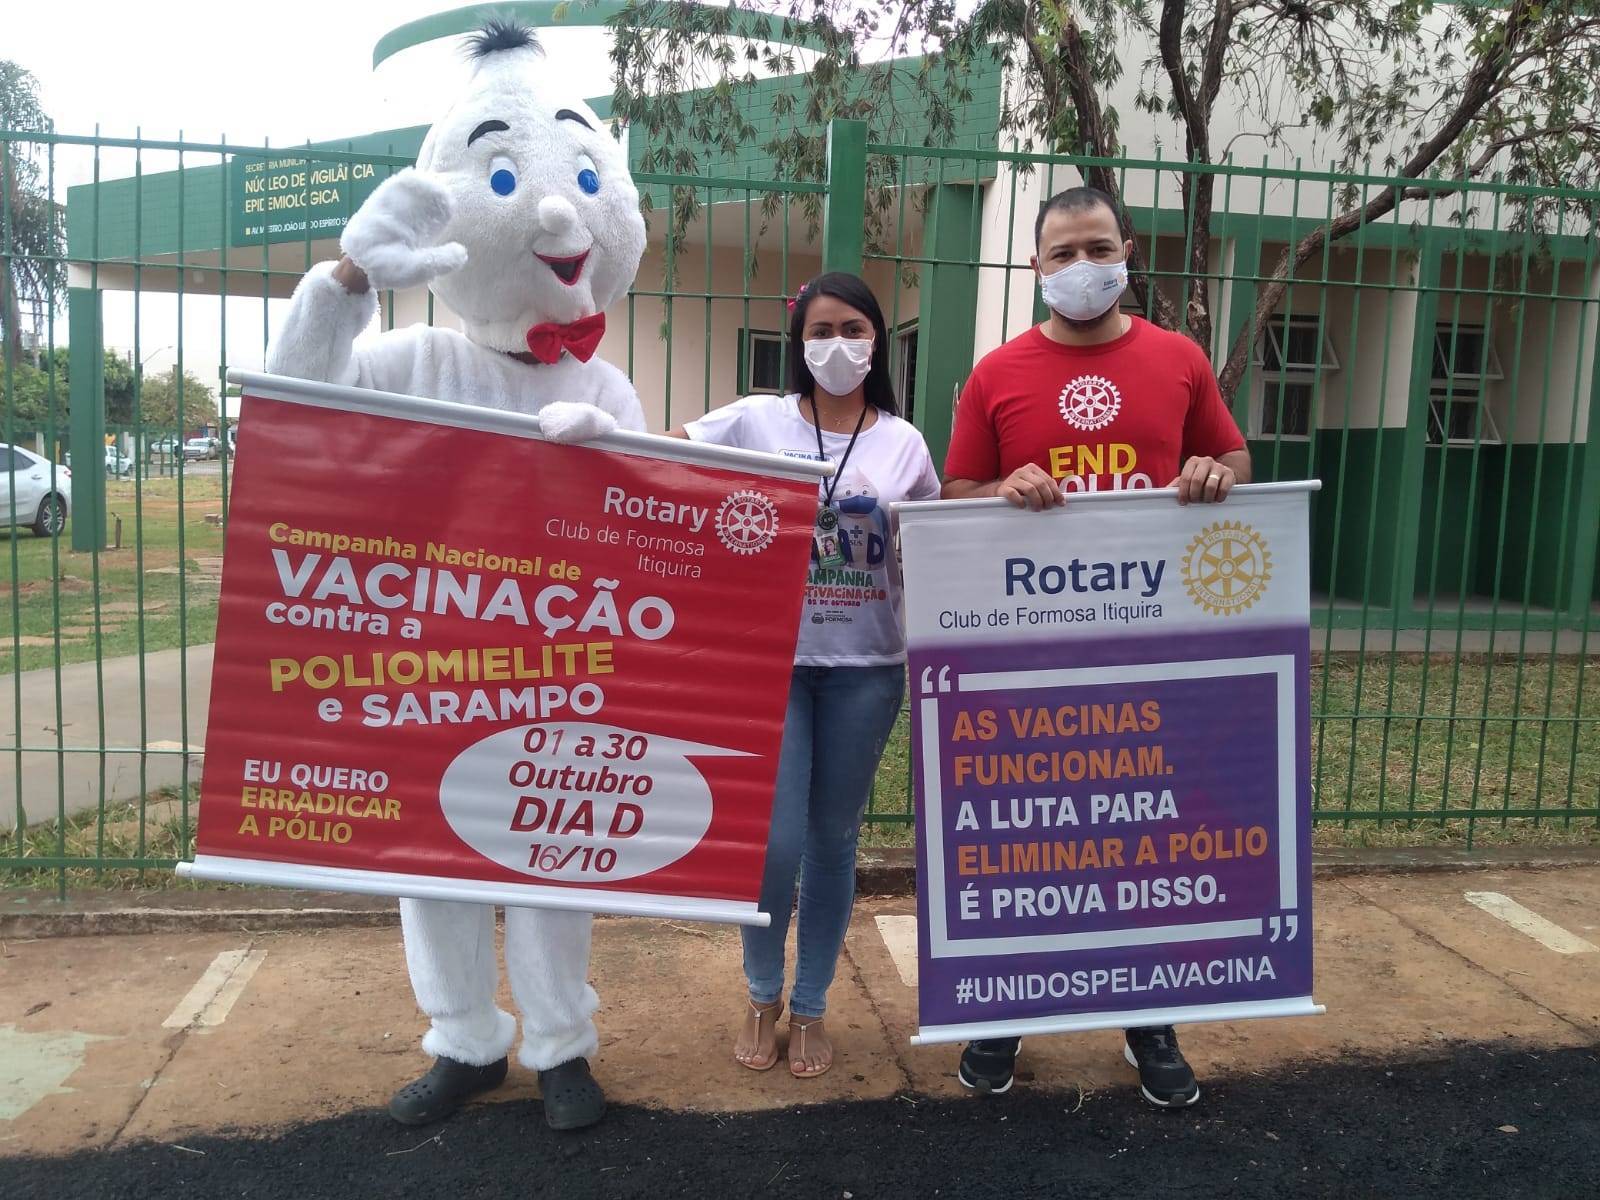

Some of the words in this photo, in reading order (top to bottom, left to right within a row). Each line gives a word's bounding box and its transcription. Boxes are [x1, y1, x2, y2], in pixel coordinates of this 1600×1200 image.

[291, 173, 306, 188] DE
[311, 163, 375, 185] VIGILÂCIA
[1049, 443, 1136, 478] END
[603, 486, 709, 533] Rotary
[268, 522, 417, 560] Campanha
[425, 542, 542, 577] Nacional
[548, 560, 581, 581] de
[546, 518, 590, 541] Club
[597, 525, 620, 545] de
[627, 529, 705, 557] Formosa
[637, 554, 702, 578] Itiquira
[806, 569, 873, 587] AMPANHA
[1005, 557, 1166, 598] Rotary
[271, 548, 675, 641] VACINAÇÃO
[804, 586, 887, 602] TIVACINAÇÃO
[265, 601, 389, 636] contra
[400, 616, 422, 640] a
[939, 610, 981, 629] Club
[987, 608, 1010, 627] de
[1016, 607, 1096, 625] Formosa
[1103, 601, 1163, 624] Itiquira
[269, 641, 615, 692] POLIOMIELITE
[318, 697, 343, 723] e
[362, 682, 605, 727] SARAMPO
[952, 709, 999, 742] AS
[1008, 700, 1162, 739] VACINAS
[523, 727, 565, 756] 01
[574, 735, 596, 758] a
[601, 733, 648, 761] 30
[243, 759, 282, 783] EU
[290, 763, 389, 793] QUERO
[509, 760, 653, 796] Outubro
[954, 745, 1174, 786] FUNCIONAM.
[240, 786, 402, 821] ERRADICAR
[509, 795, 594, 837] DIA
[607, 802, 644, 839] D
[955, 800, 980, 831] A
[990, 796, 1080, 830] LUTA
[1090, 789, 1179, 825] PARA
[238, 814, 260, 836] A
[268, 811, 353, 844] PÓLIO
[528, 843, 618, 873] 16/10
[958, 837, 1126, 876] ELIMINAR
[1135, 835, 1158, 866] A
[1169, 824, 1268, 863] PÓLIO
[959, 882, 981, 920] É
[992, 884, 1106, 919] PROVA
[1117, 874, 1226, 911] DISSO.
[955, 955, 1277, 1005] #UNIDOSPELAVACINA
